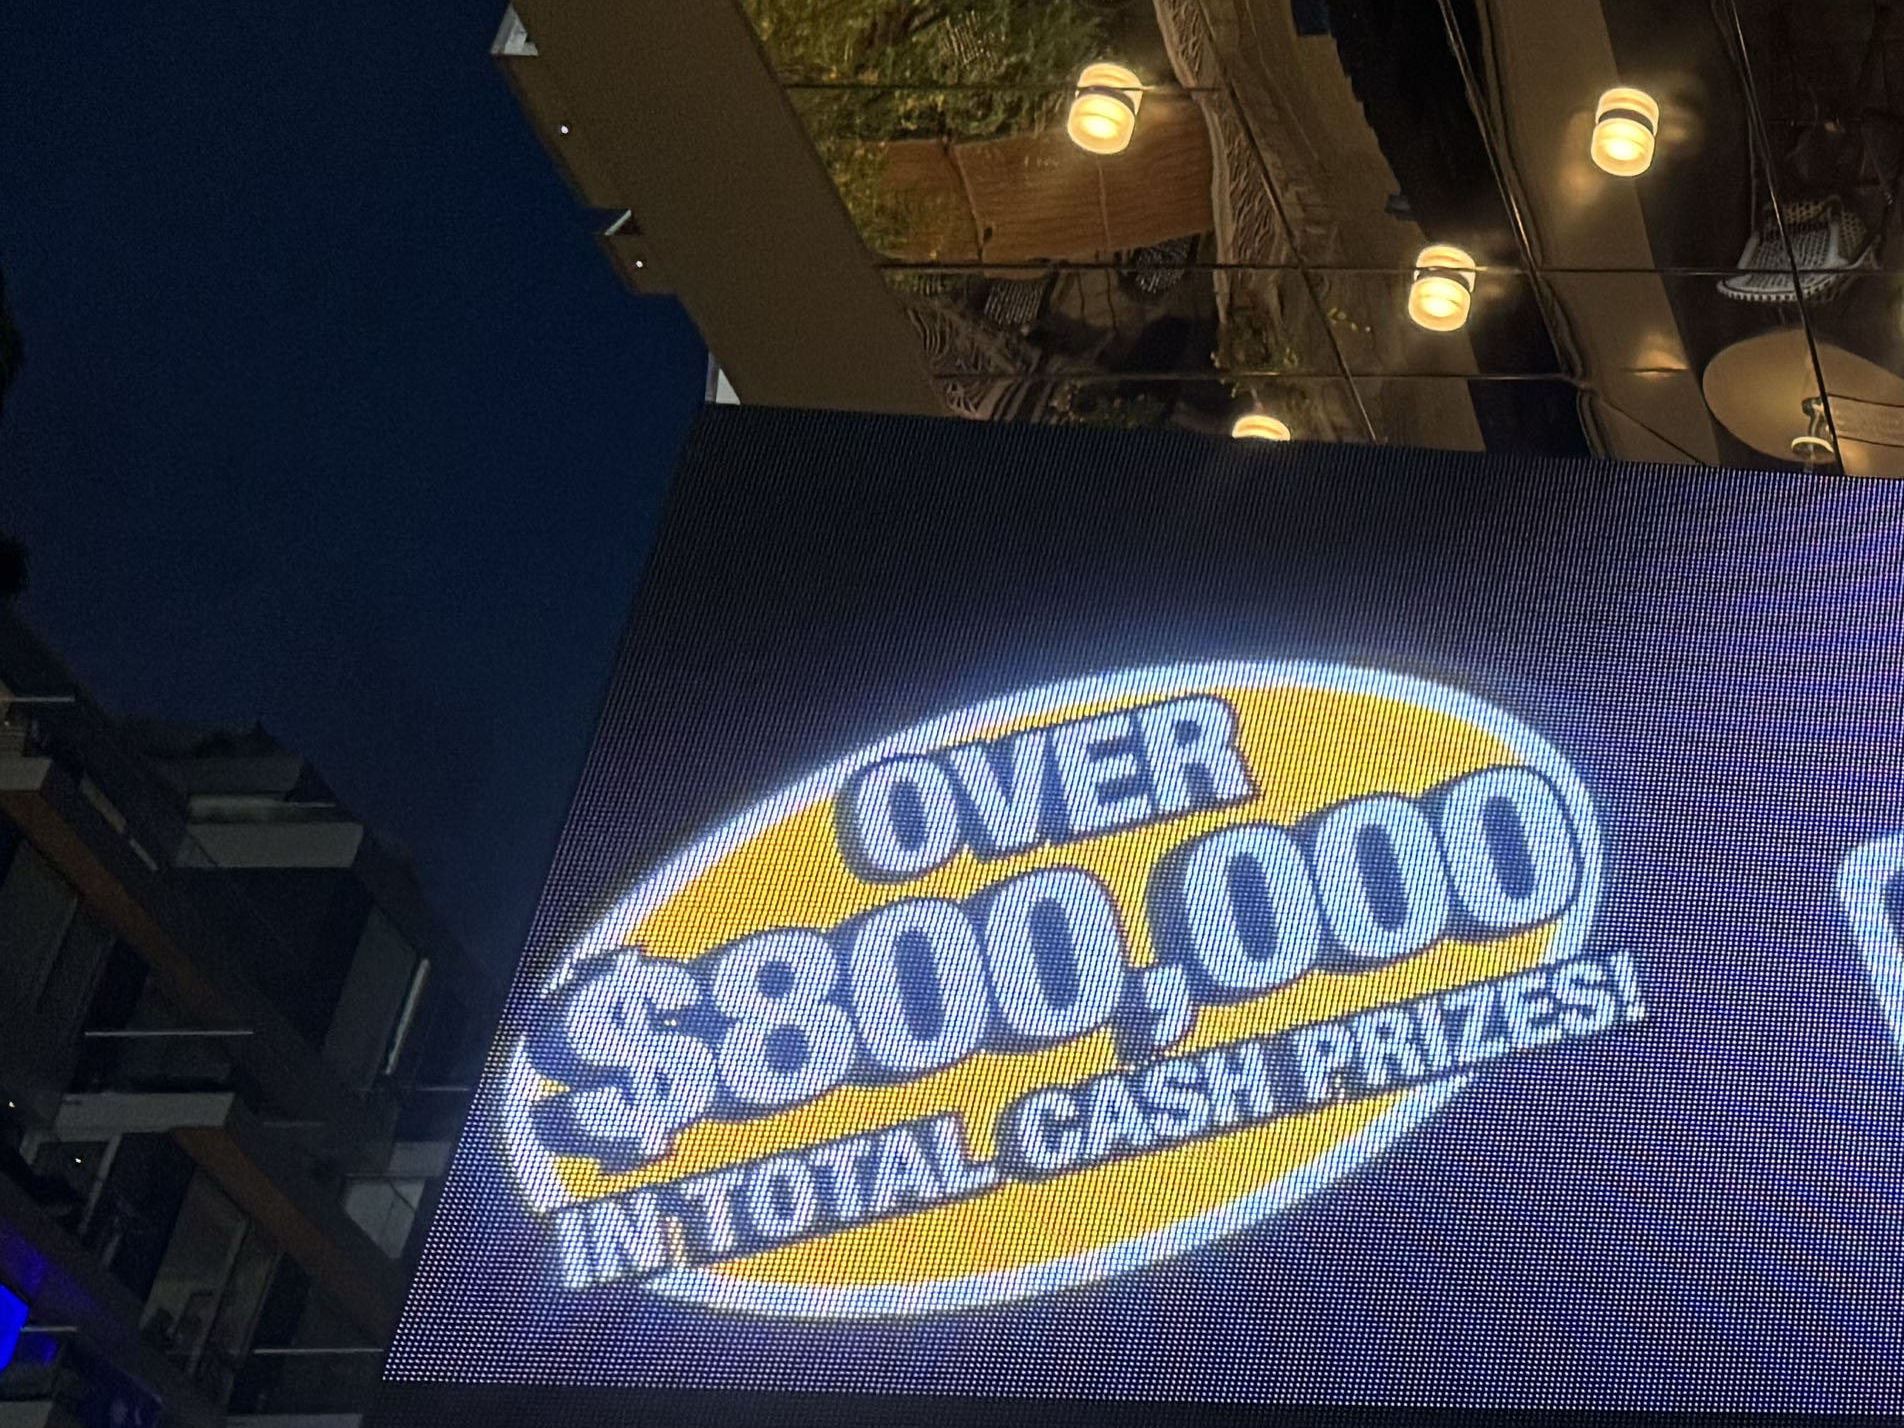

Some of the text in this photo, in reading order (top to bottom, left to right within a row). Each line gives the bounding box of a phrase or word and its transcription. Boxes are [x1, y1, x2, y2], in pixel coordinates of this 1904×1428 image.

[852, 694, 1260, 875] OVER
[560, 766, 1585, 1159] $800,000
[560, 948, 1648, 1289] IN TOTAL CASH PRIZES!
